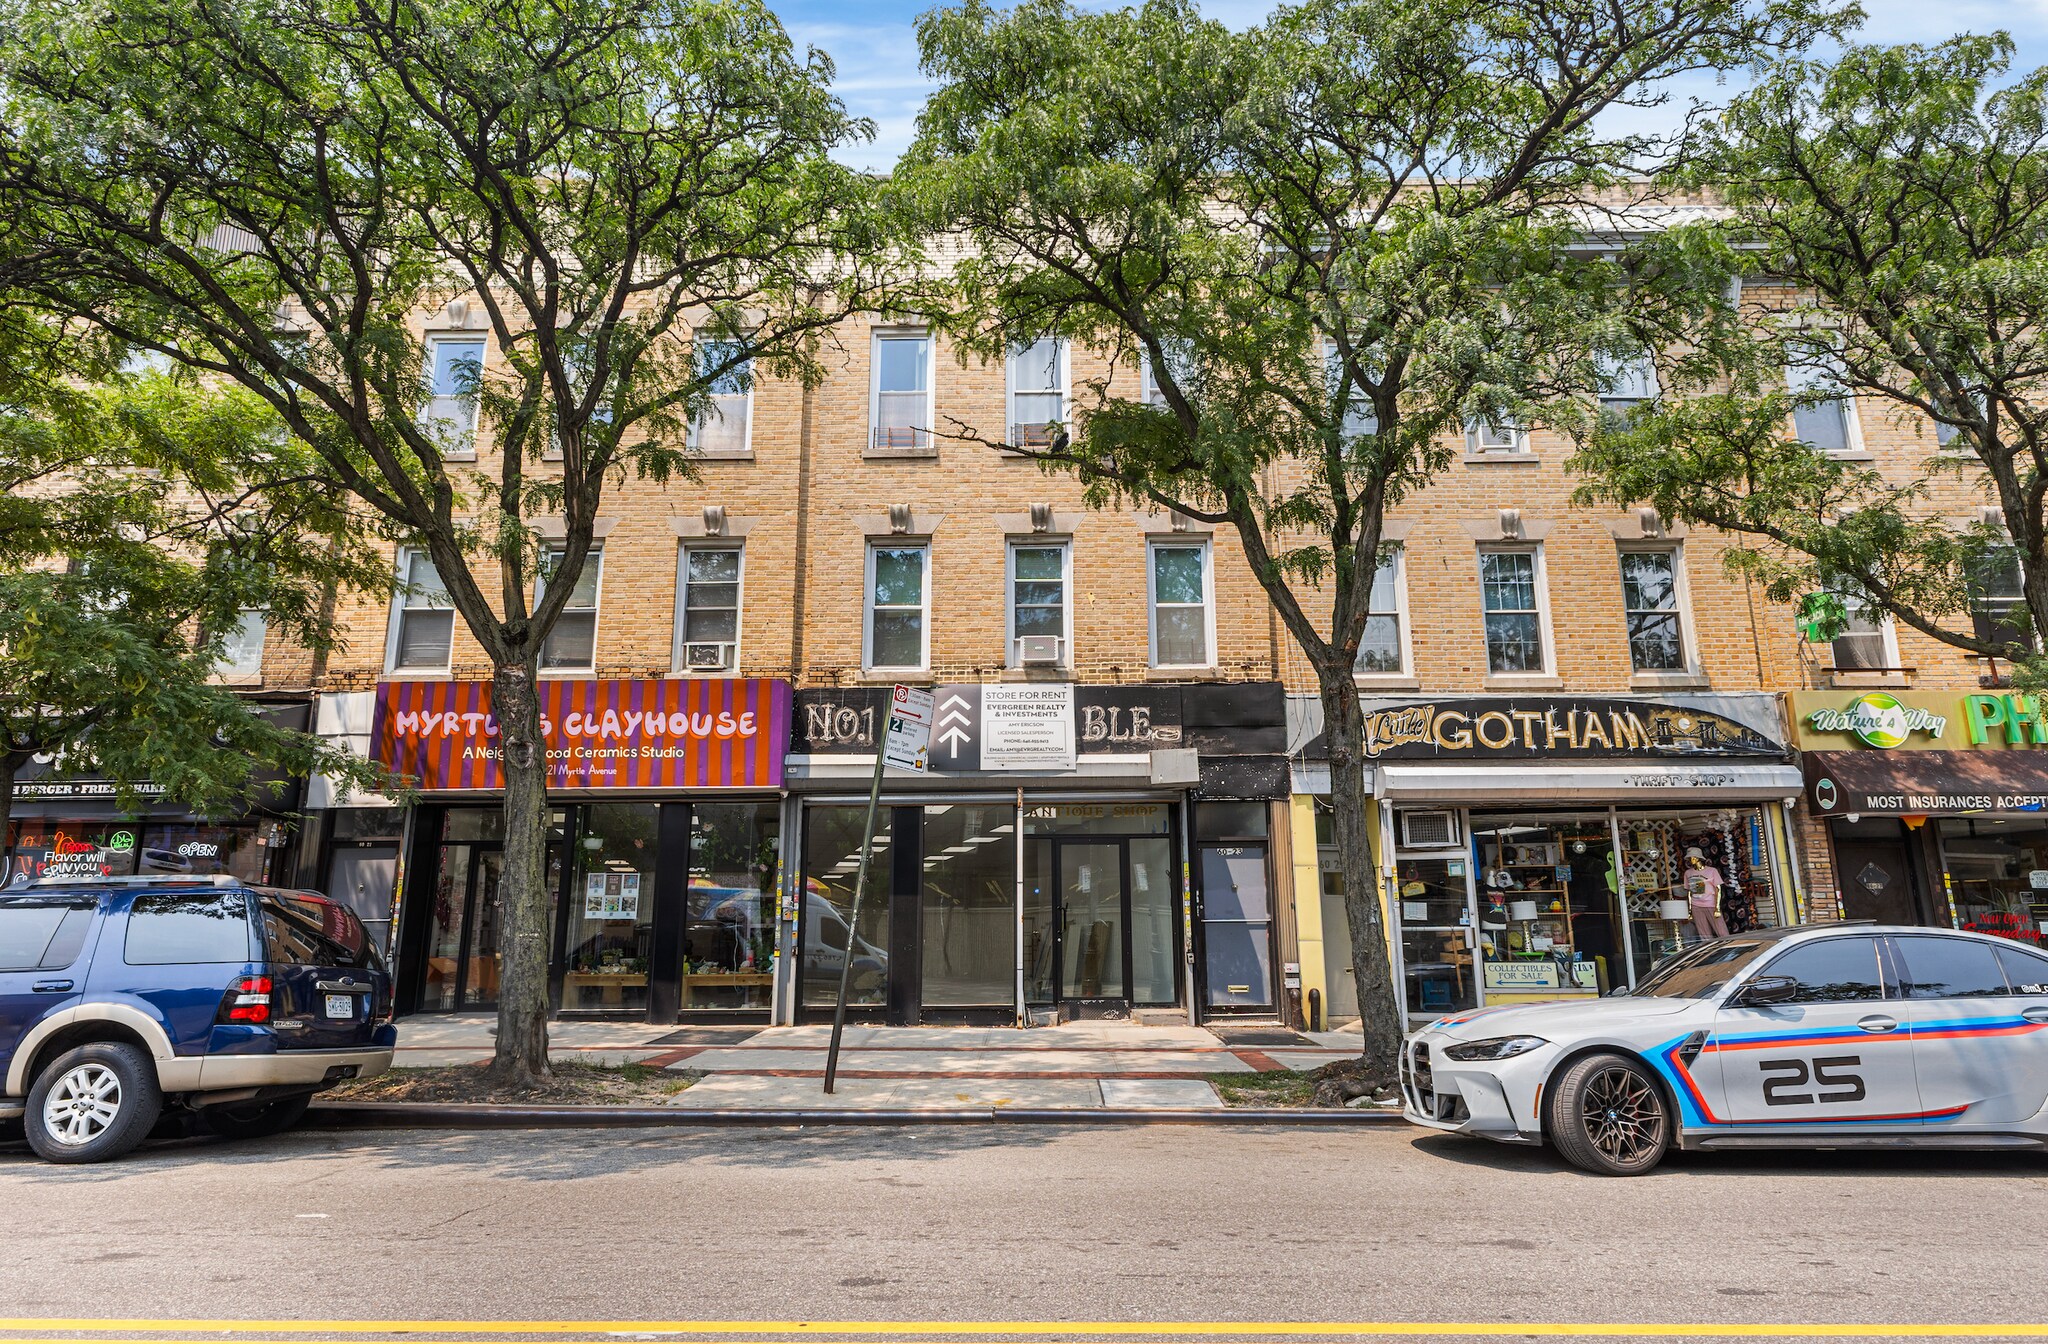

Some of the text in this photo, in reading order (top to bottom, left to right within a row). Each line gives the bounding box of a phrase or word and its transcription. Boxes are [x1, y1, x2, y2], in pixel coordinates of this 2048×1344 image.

[1798, 609, 1826, 628] FARACIA
[985, 691, 1067, 700] STORE FOR RENT
[394, 708, 758, 741] MYRTLS CLAYHOUSE
[892, 718, 900, 732] 2
[1370, 709, 1655, 750] Little GOTHAM
[1812, 709, 1946, 738] Nature's Way
[462, 745, 685, 761] A Neigood Ceramics Studio
[558, 764, 586, 778] Myrtle
[588, 764, 617, 775] Avenue
[1630, 775, 1727, 787] THRIFT SHOP
[1866, 795, 2048, 809] MOST INSURANCES ACCEPT
[1113, 805, 1158, 817] SHOP
[178, 841, 218, 857] OPEN
[44, 851, 106, 863] Flavor will
[73, 862, 97, 873] you
[2003, 912, 2029, 926] Open
[1488, 964, 1553, 973] COLLECTIBLES
[1759, 1055, 1866, 1106] 25
